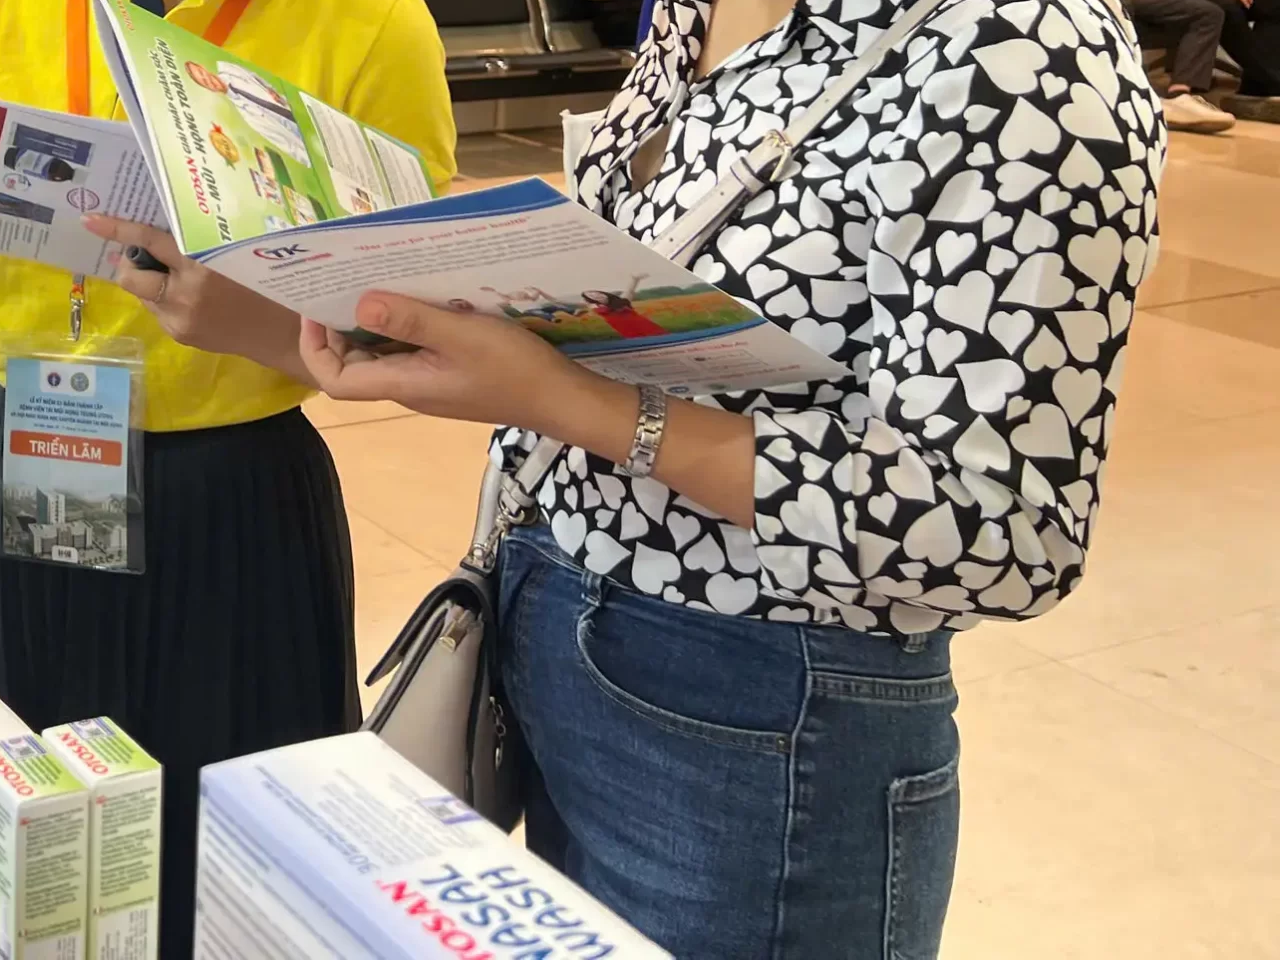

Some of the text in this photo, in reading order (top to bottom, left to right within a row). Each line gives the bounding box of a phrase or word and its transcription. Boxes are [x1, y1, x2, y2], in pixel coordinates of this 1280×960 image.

[187, 157, 210, 215] OTOSAN
[217, 217, 231, 243] TAI
[29, 437, 101, 460] TRIỂN LÃM
[58, 731, 108, 775] OTOSAN
